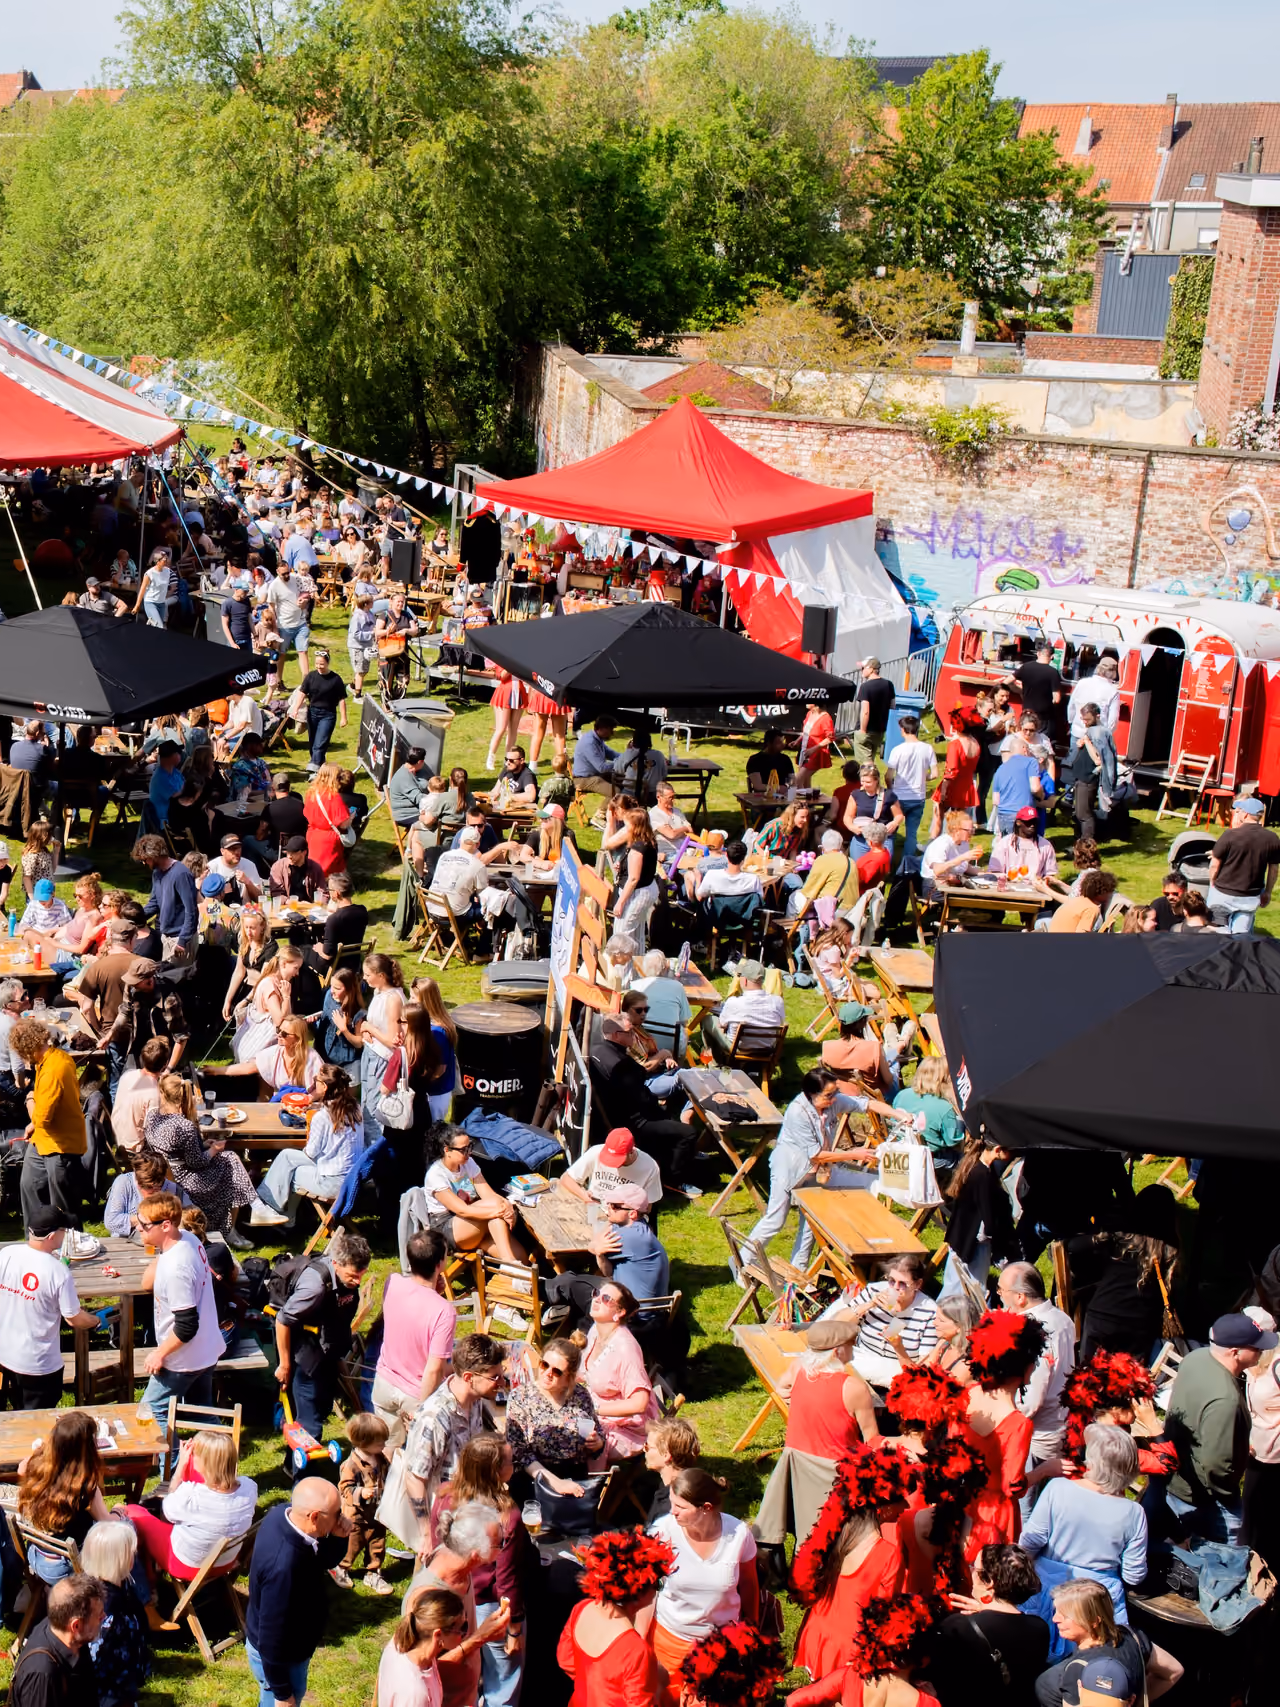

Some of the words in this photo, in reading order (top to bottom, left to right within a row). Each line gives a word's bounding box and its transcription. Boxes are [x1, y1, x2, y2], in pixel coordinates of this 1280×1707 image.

[235, 668, 263, 685] OMER.
[787, 688, 830, 700] OMER.
[46, 703, 92, 720] OMER.
[475, 1079, 524, 1094] OMER.
[595, 1171, 635, 1185] RIVERSI
